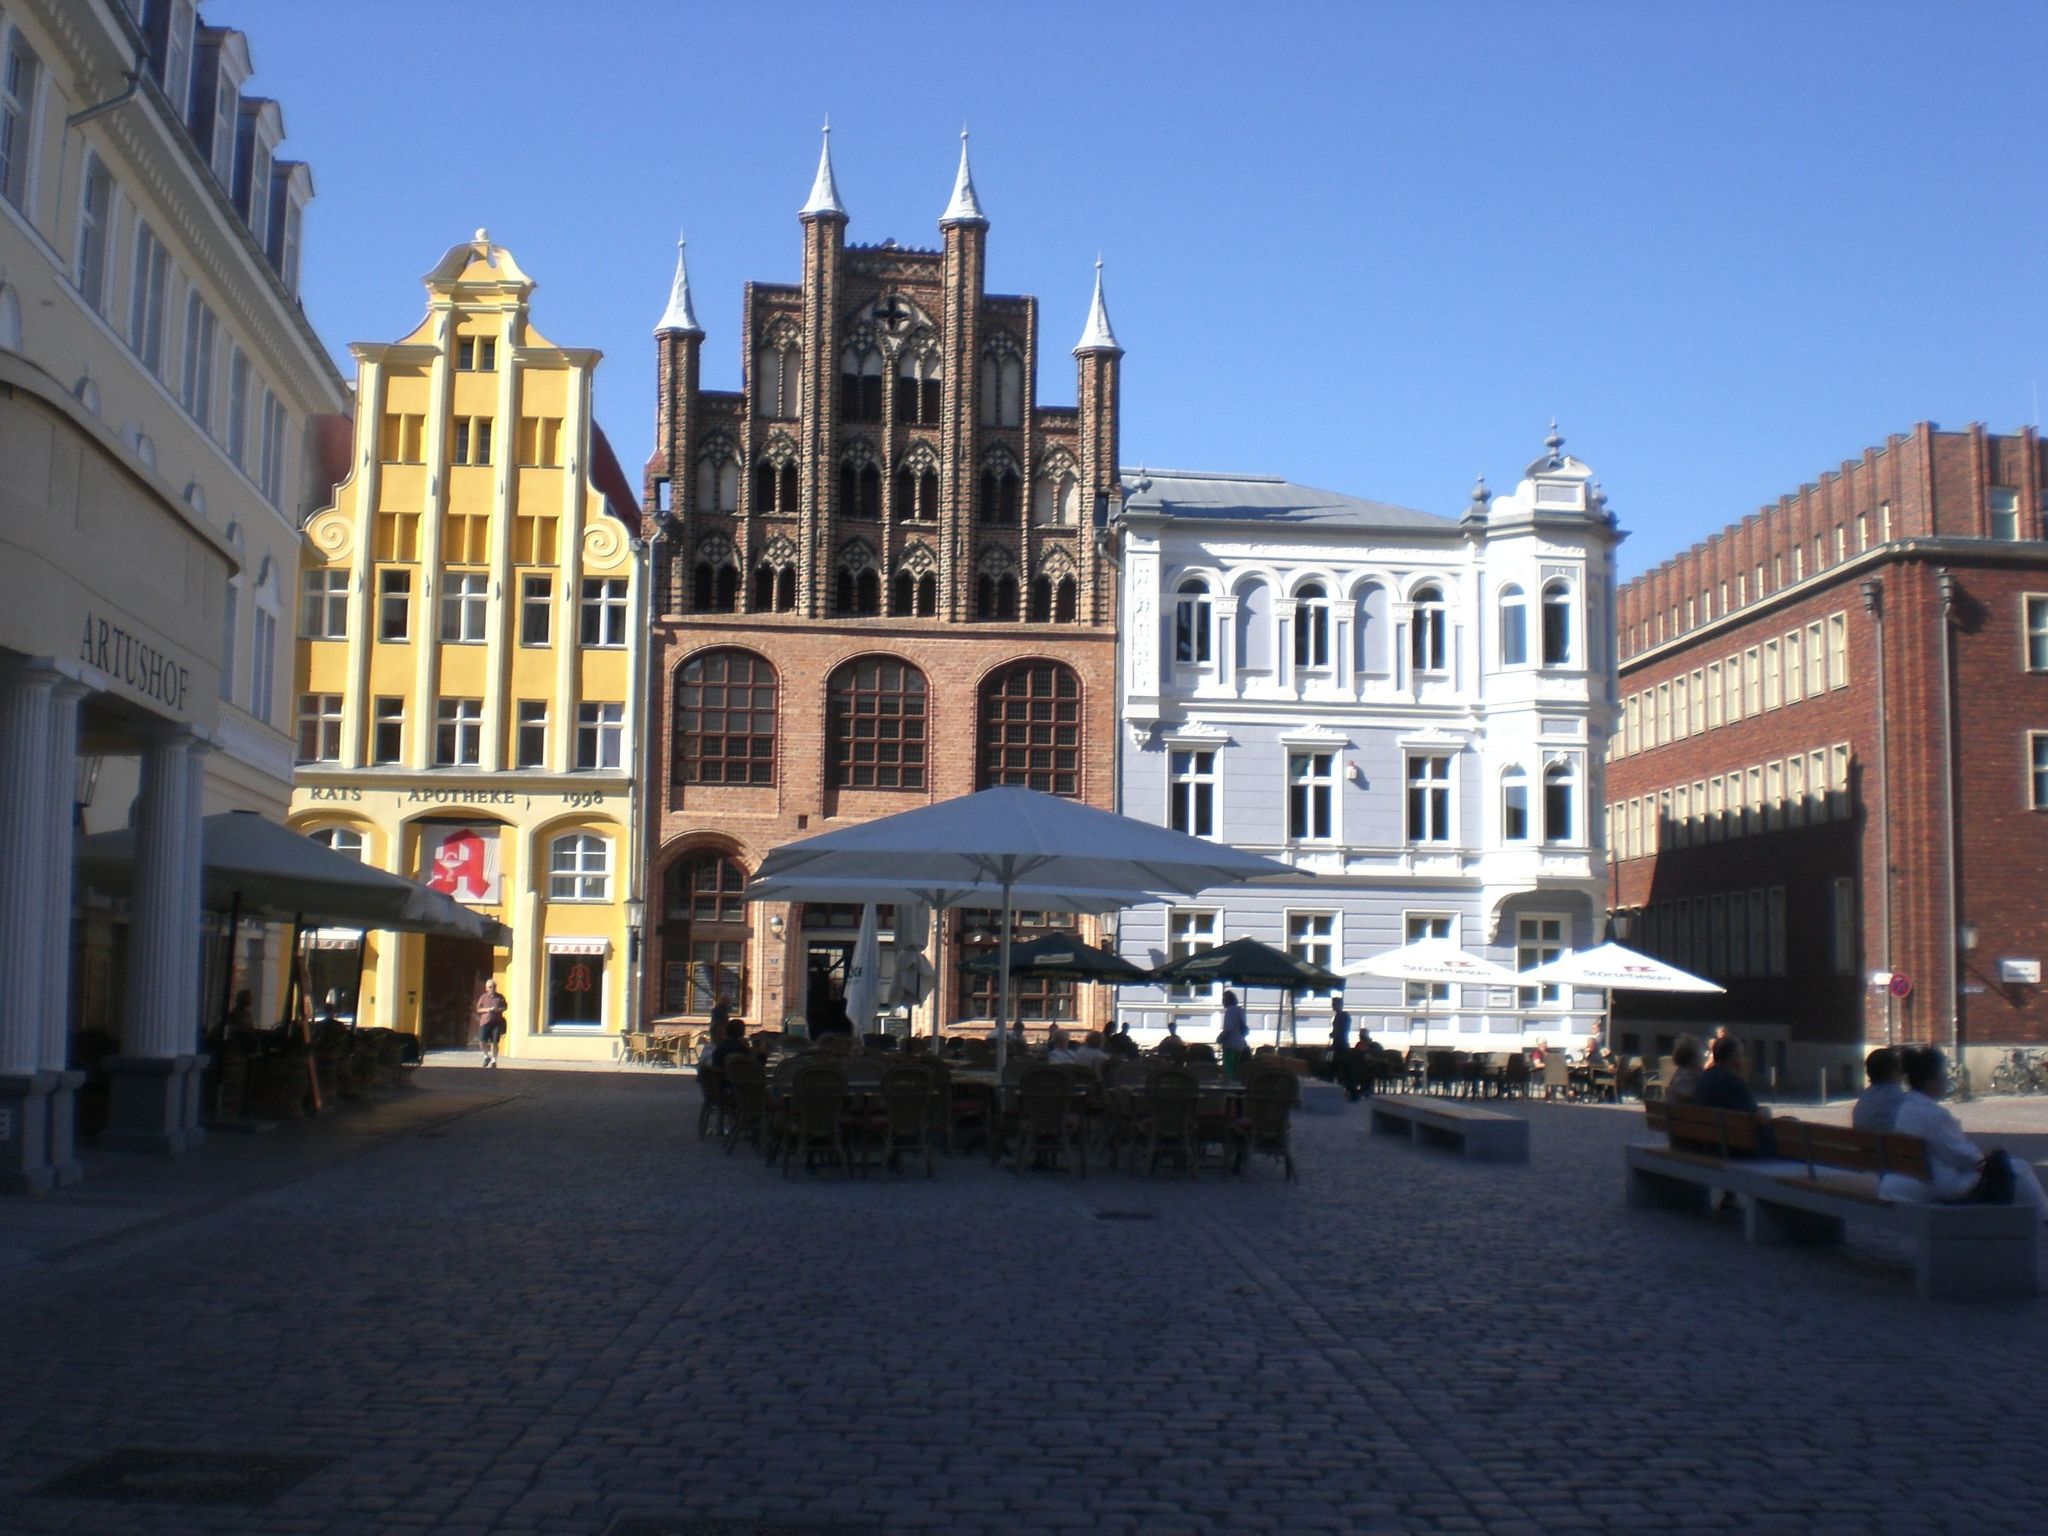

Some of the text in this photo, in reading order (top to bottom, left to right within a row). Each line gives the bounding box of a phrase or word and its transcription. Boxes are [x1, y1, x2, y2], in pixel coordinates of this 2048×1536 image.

[80, 609, 188, 711] ARTUSHOF
[310, 786, 604, 808] RATS APOTHEKE 1998
